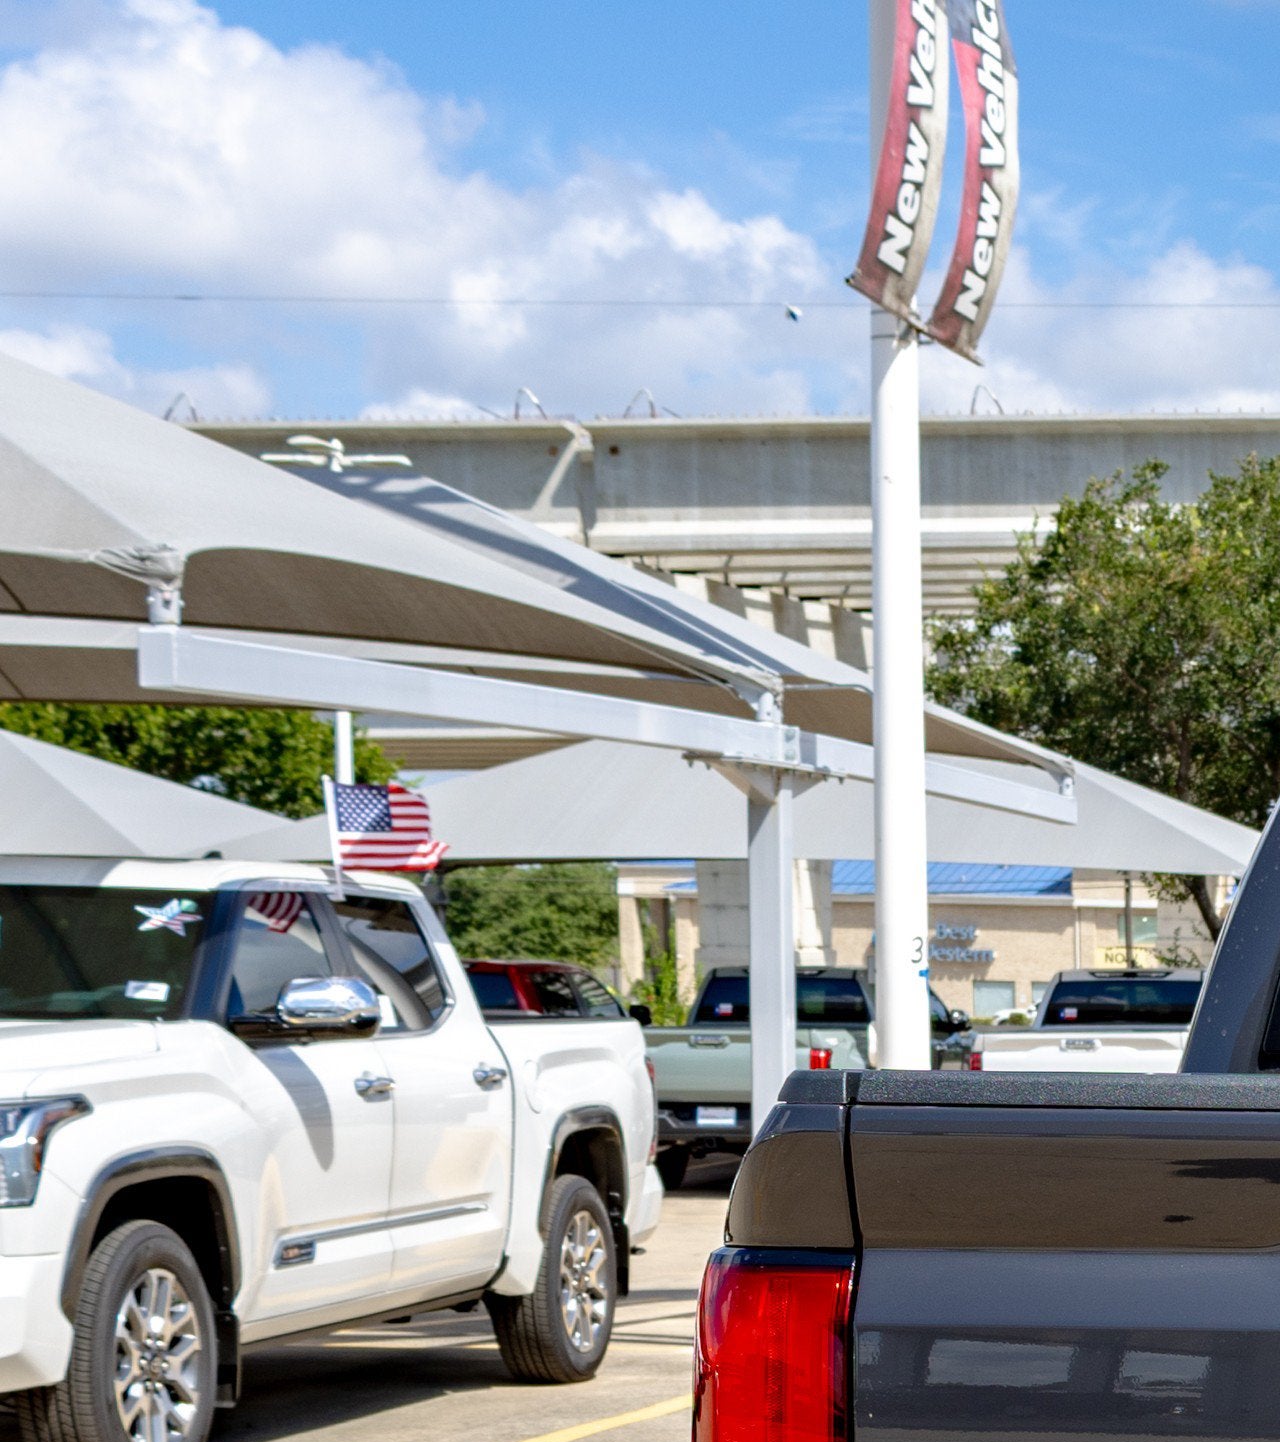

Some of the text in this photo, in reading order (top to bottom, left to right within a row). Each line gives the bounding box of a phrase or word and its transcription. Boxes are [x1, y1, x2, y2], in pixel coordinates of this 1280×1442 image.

[876, 121, 930, 276] New
[953, 0, 1006, 323] New Vehic
[935, 922, 976, 941] Best
